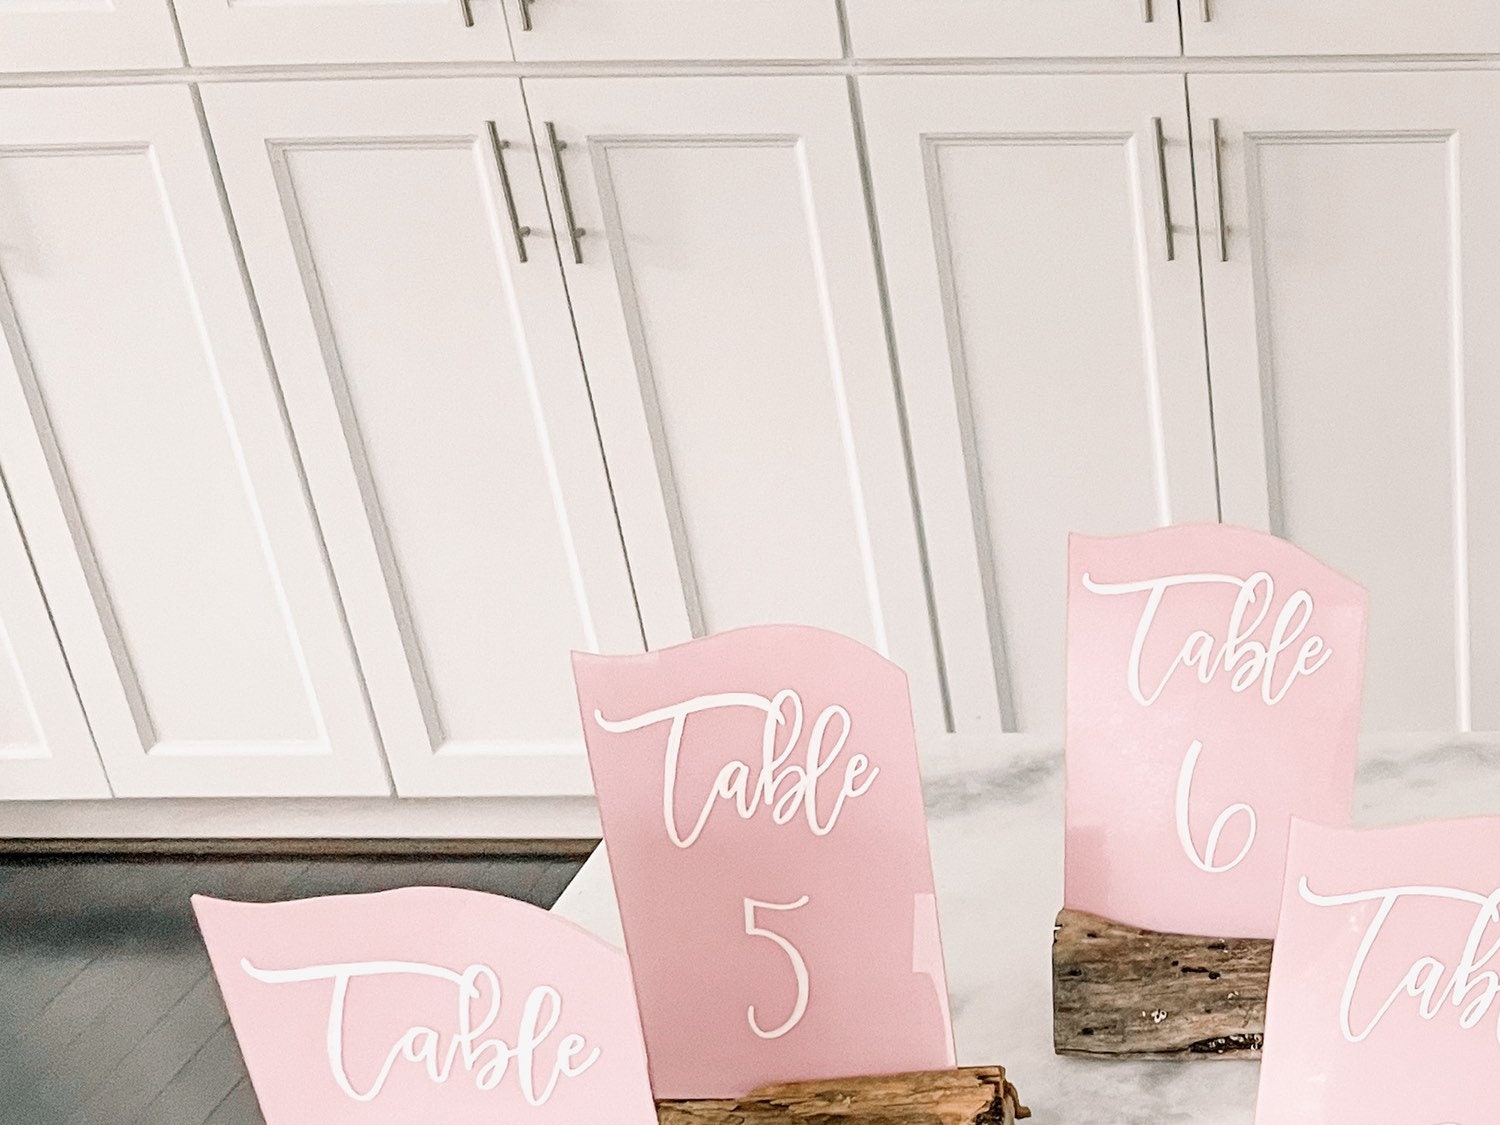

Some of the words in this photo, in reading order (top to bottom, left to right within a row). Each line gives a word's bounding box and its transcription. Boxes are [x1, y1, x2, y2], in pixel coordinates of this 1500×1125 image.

[1083, 571, 1332, 706] Table
[594, 688, 879, 849] Table
[1176, 740, 1256, 873] 6
[240, 957, 600, 1106] Table
[744, 895, 810, 1039] 5
